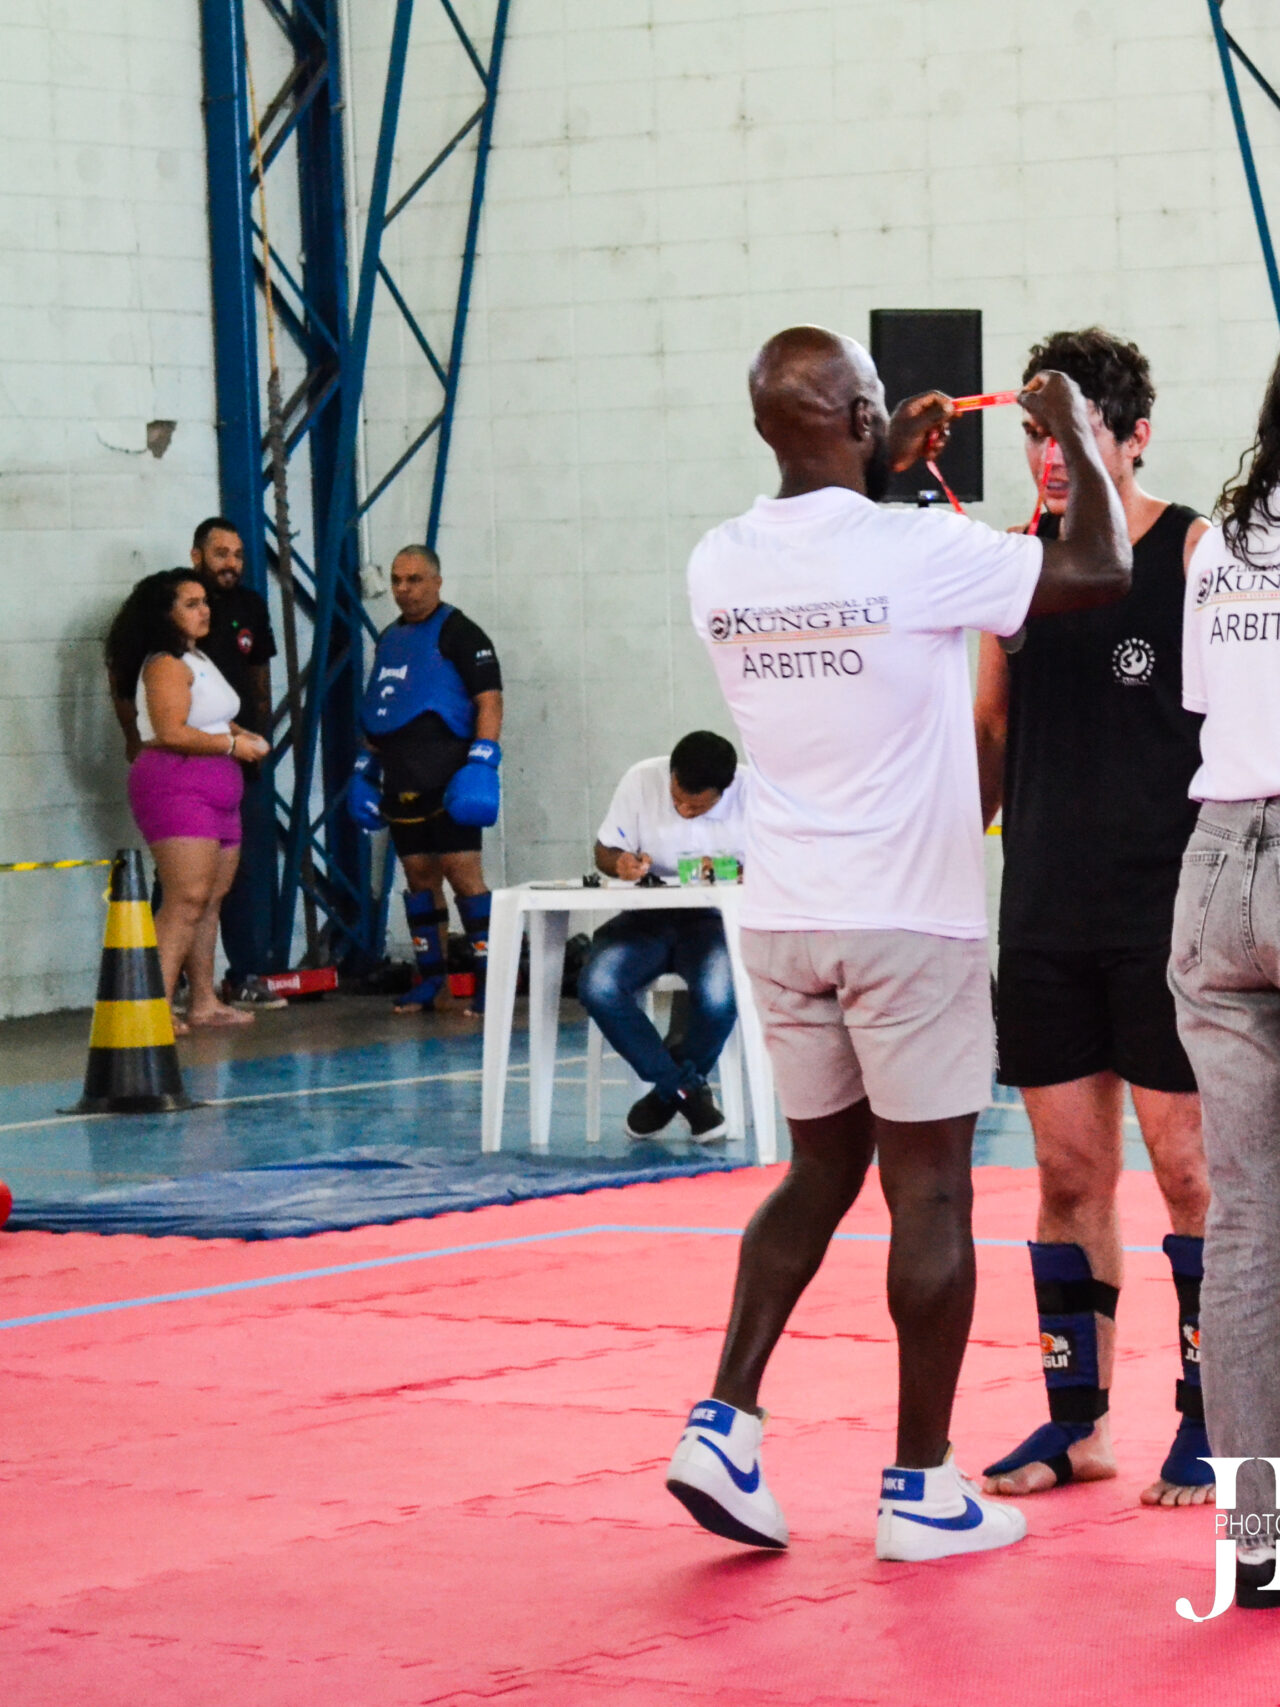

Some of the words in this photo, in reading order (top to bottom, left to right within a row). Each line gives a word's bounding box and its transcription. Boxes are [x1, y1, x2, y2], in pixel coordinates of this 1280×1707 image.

[732, 608, 831, 634] KUNG
[839, 607, 890, 627] FU
[742, 646, 864, 679] ÁRBITRO
